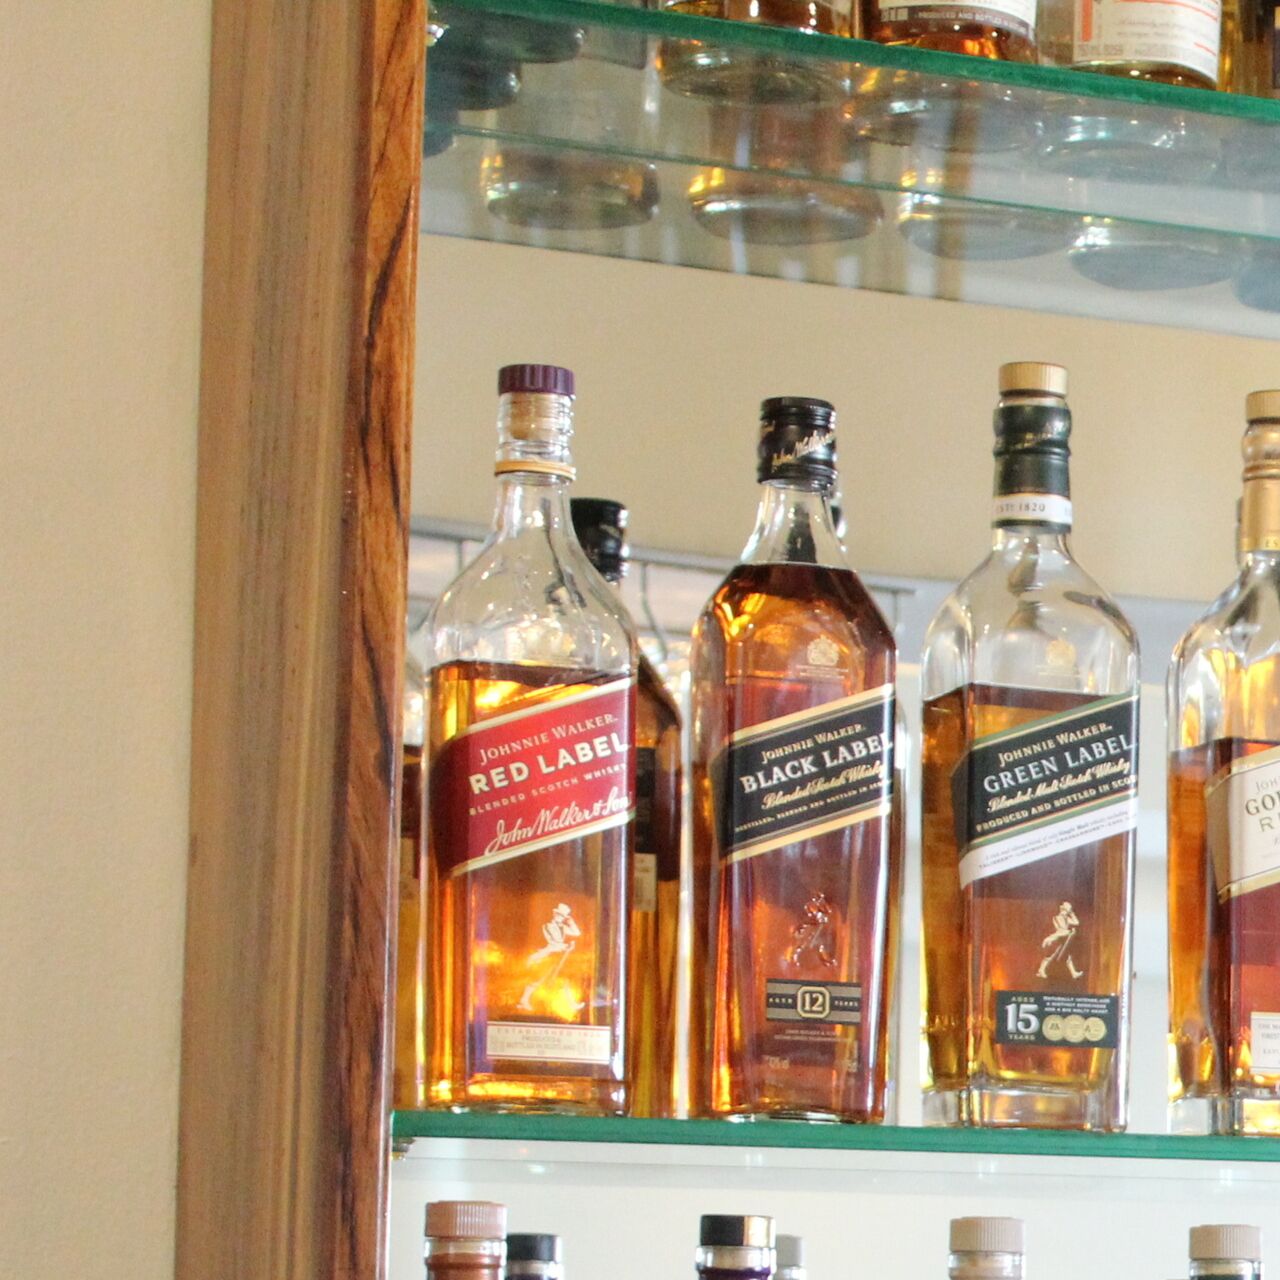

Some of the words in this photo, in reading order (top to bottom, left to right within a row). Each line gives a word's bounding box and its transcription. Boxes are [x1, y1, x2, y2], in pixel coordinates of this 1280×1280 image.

[1019, 502, 1046, 512] 1820
[469, 762, 530, 794] RED
[537, 733, 629, 774] LABEL
[480, 733, 550, 766] JOHNNIE
[552, 713, 614, 739] WALKER
[740, 755, 819, 794] BLACK
[822, 733, 893, 767] LABEL
[761, 738, 814, 764] JOHNNIE
[815, 723, 862, 743] WALKER
[984, 757, 1059, 793] GREEN
[1065, 734, 1134, 768] LABEL
[998, 739, 1056, 768] JOHNNIE
[1056, 722, 1108, 745] WALKER
[469, 793, 526, 816] BLENDED
[531, 777, 579, 796] SCOTCH
[584, 763, 627, 780] WHISKY
[976, 807, 1029, 832] PRODUCED
[1032, 800, 1051, 814] AND
[1054, 788, 1097, 808] BOTTLED
[1099, 783, 1110, 792] IN
[804, 993, 823, 1011] 12
[1006, 1004, 1039, 1033] 15
